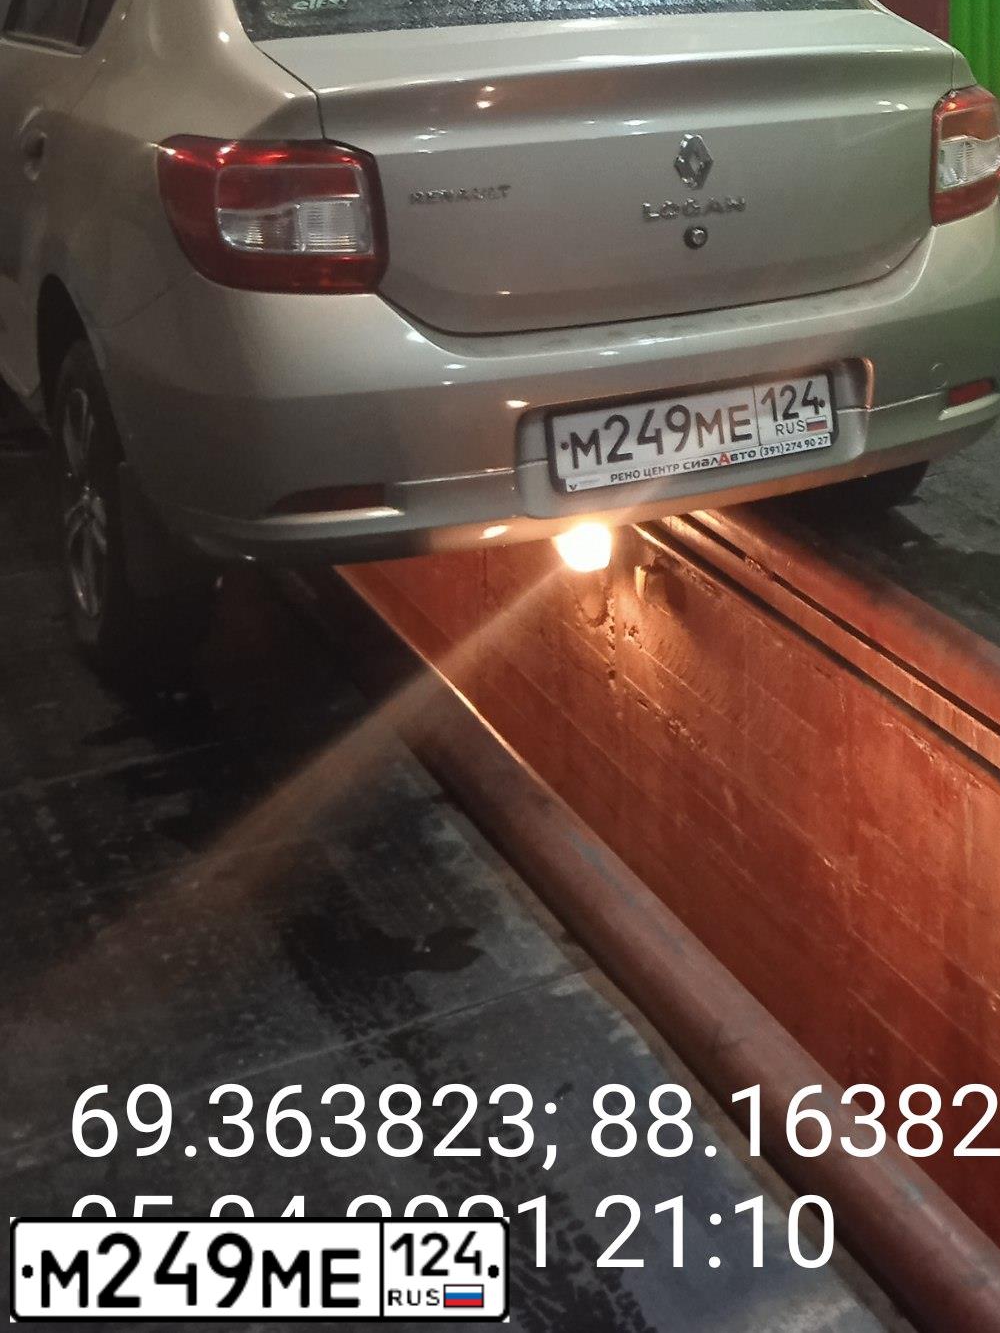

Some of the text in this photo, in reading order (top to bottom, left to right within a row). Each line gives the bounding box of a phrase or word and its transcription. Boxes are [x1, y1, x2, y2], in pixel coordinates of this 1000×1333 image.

[641, 195, 746, 221] LOGAN
[761, 381, 820, 422] 124
[775, 418, 806, 436] RUS
[610, 470, 641, 483] РЕНО
[643, 463, 681, 478] ЦЕНТР
